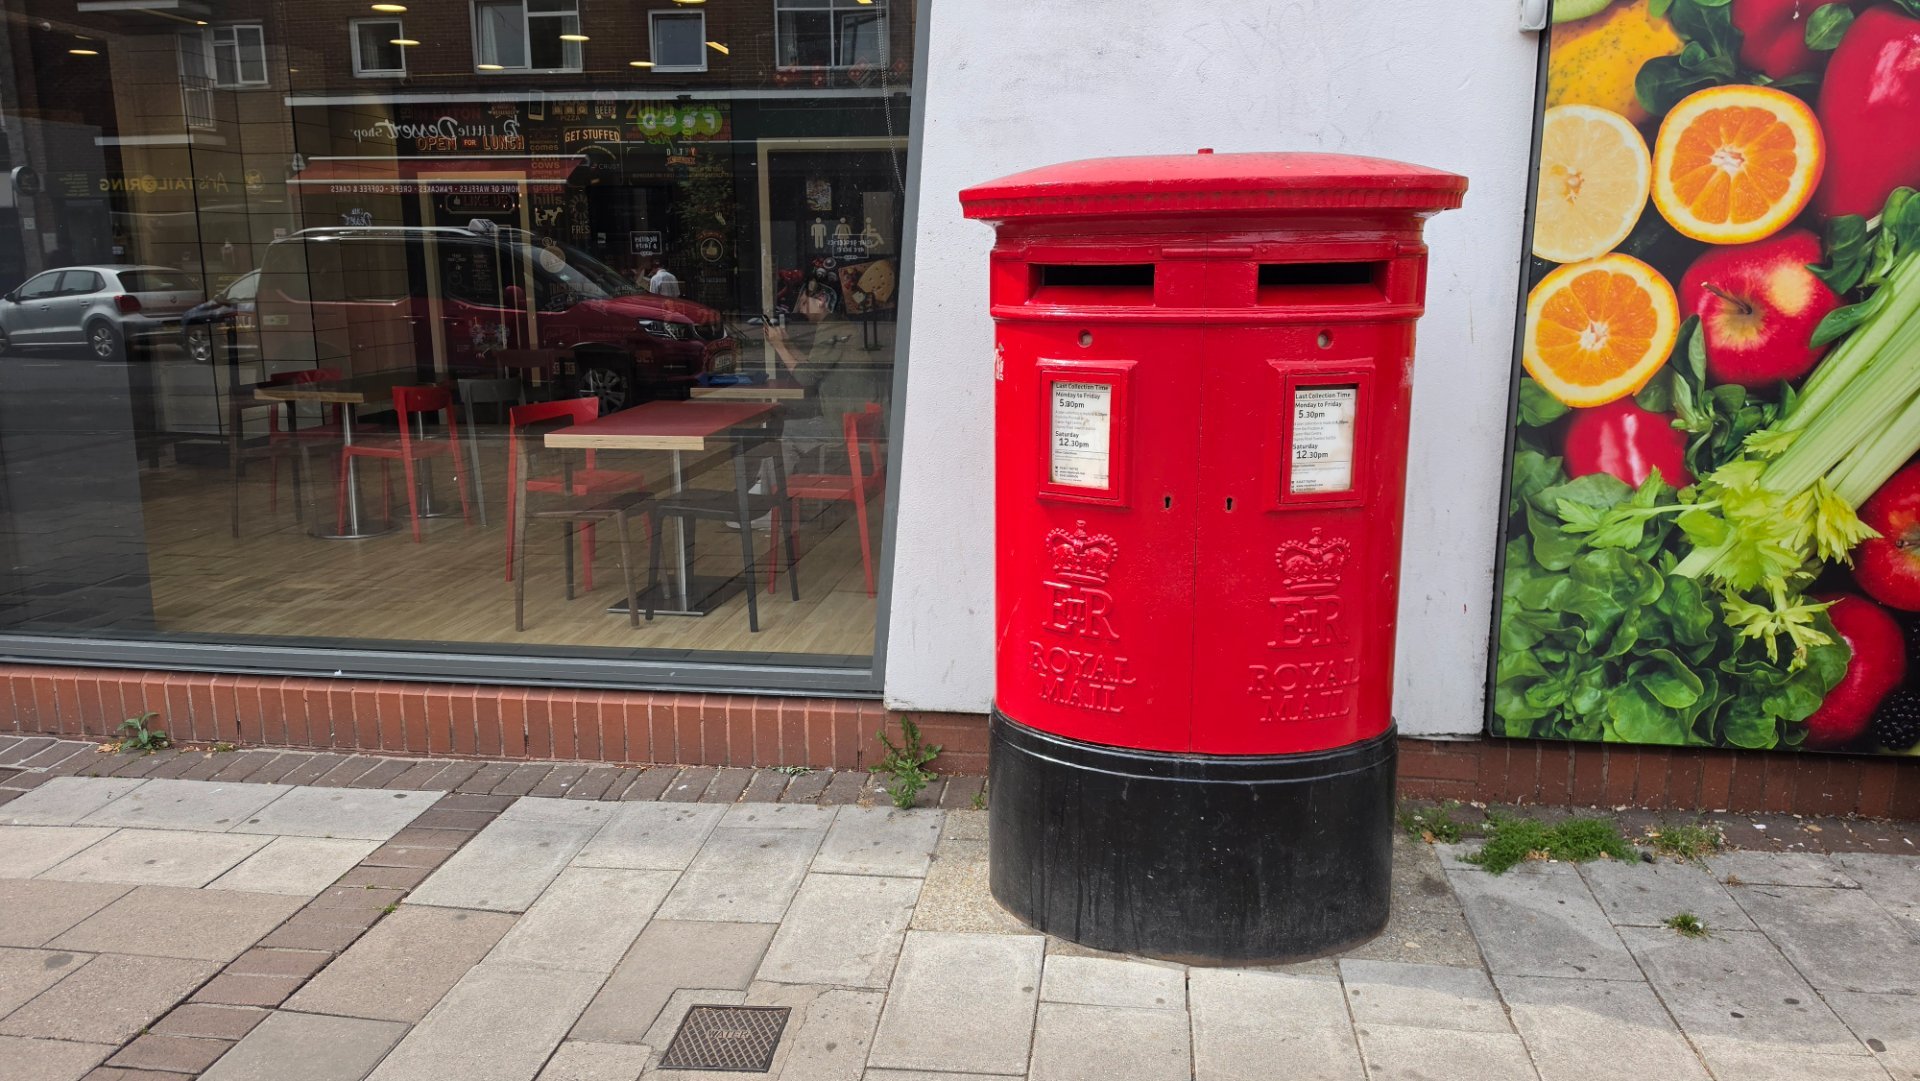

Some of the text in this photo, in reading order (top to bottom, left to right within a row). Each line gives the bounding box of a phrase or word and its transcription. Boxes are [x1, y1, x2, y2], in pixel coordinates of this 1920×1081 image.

[416, 136, 458, 150] OPEN
[482, 135, 526, 151] LUNCH
[565, 129, 581, 143] GET
[582, 129, 620, 143] STUFFED
[1298, 410, 1326, 419] 5.30pm
[1055, 431, 1080, 439] Saturday
[1059, 438, 1089, 448] 12.30pm
[1296, 450, 1329, 460] 12.30pm
[1029, 640, 1137, 684] ROYAL
[1248, 657, 1360, 694] ROYAL
[1038, 677, 1125, 713] MAIL
[1259, 688, 1350, 722] MAIL
[707, 1030, 750, 1039] WATER
